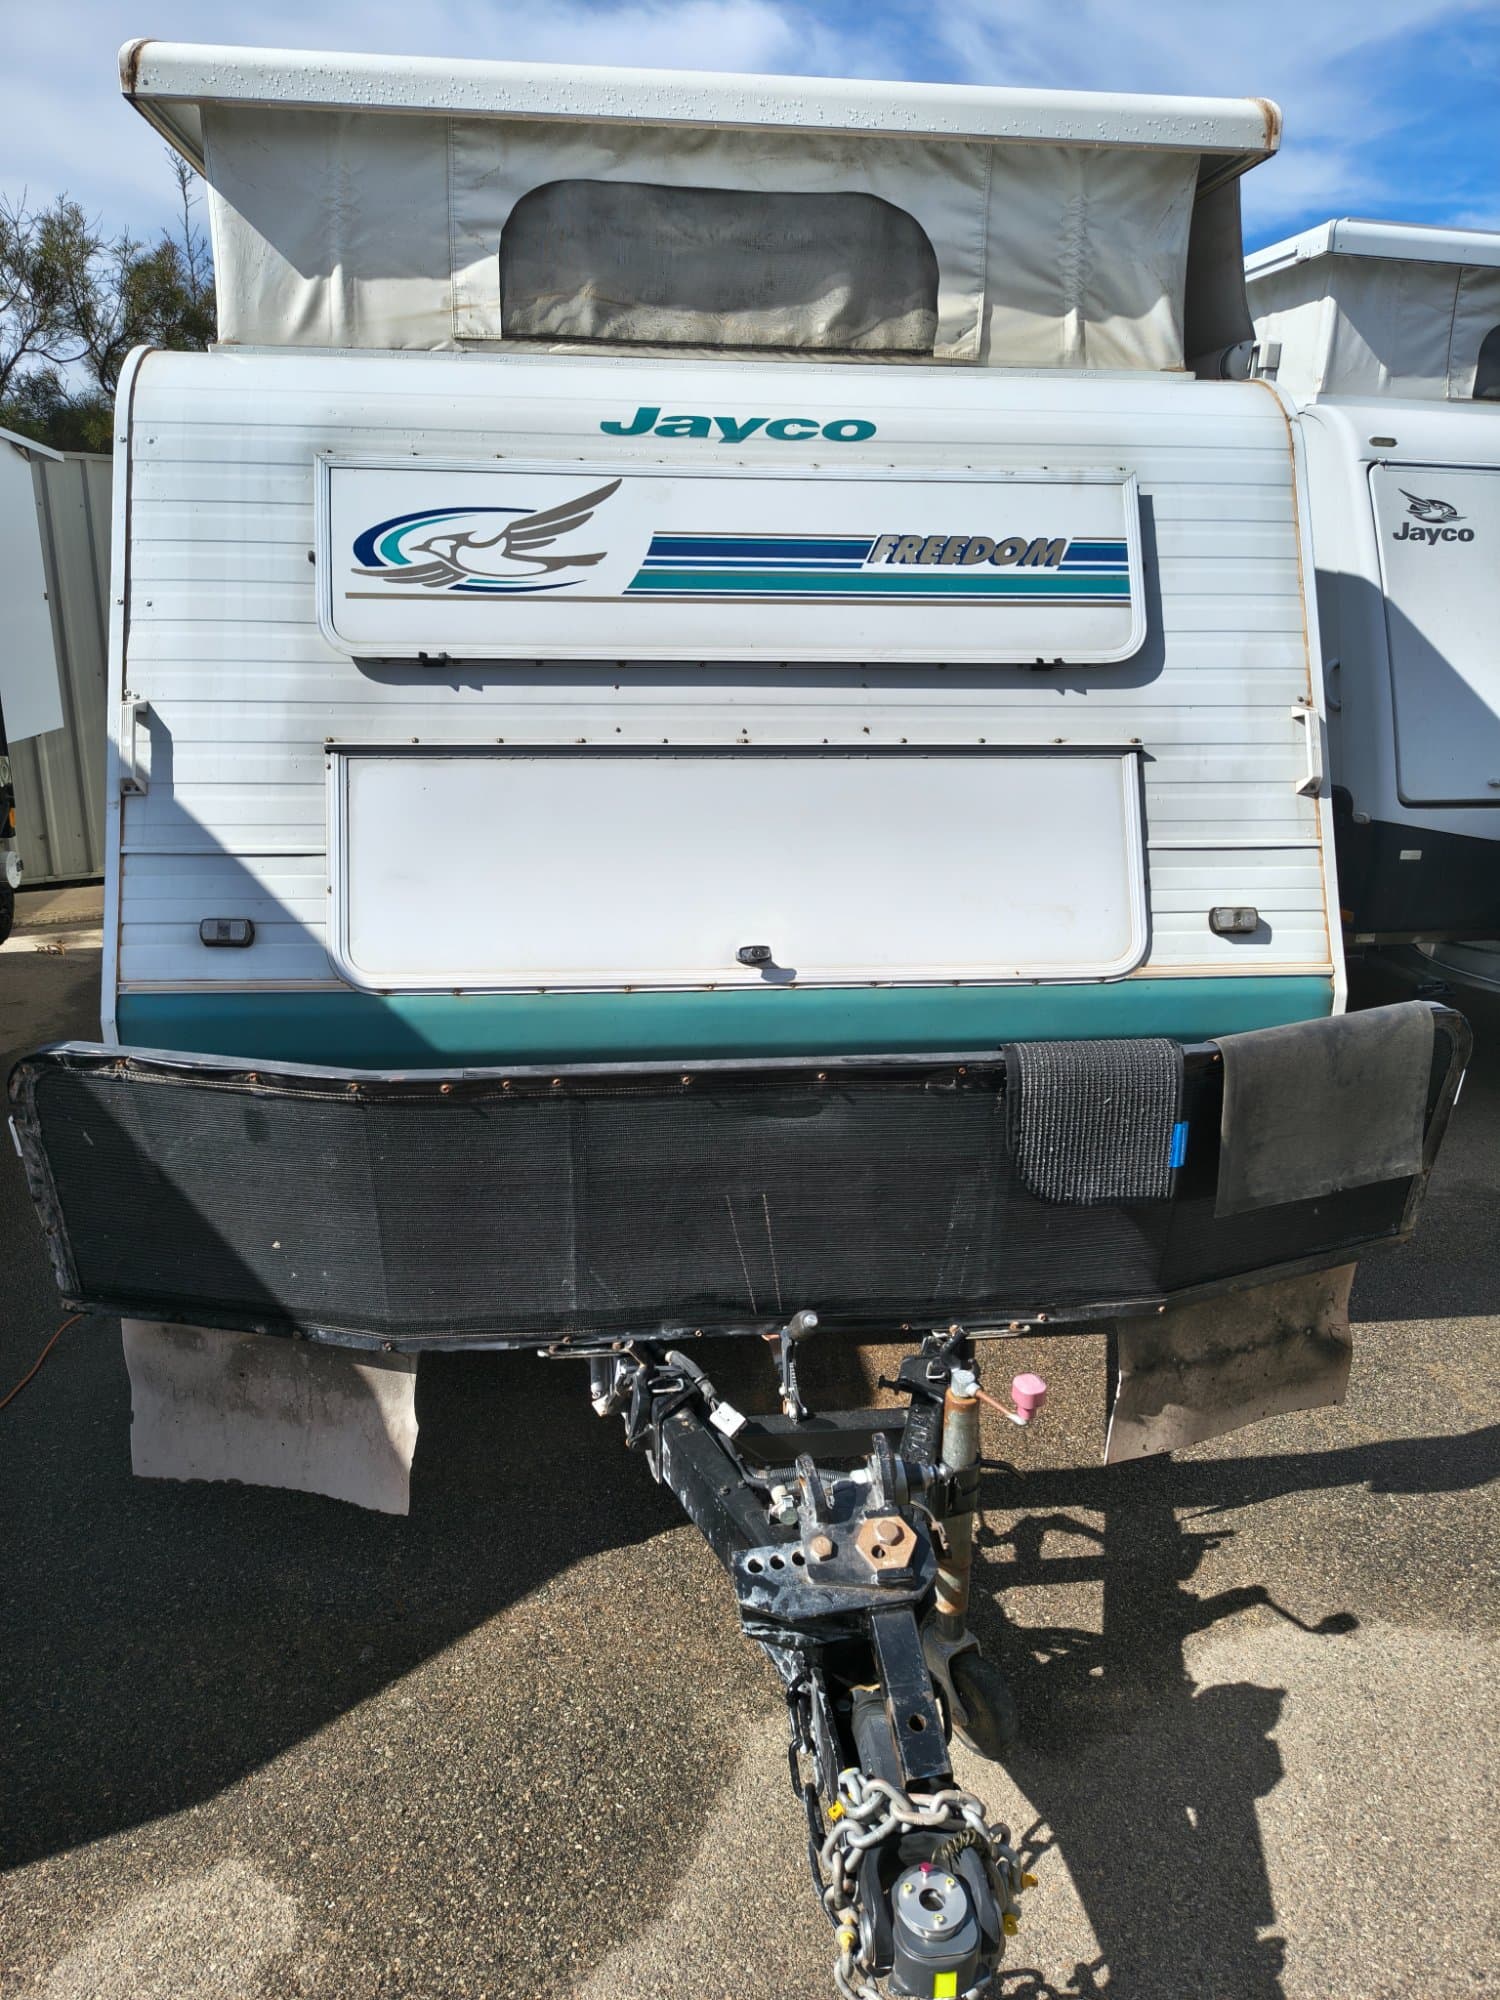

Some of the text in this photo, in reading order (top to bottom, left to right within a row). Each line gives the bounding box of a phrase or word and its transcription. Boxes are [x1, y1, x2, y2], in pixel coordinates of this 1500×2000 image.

[600, 406, 877, 443] Jayco
[867, 533, 1067, 567] FREEDOM
[1392, 522, 1475, 546] Jayco
